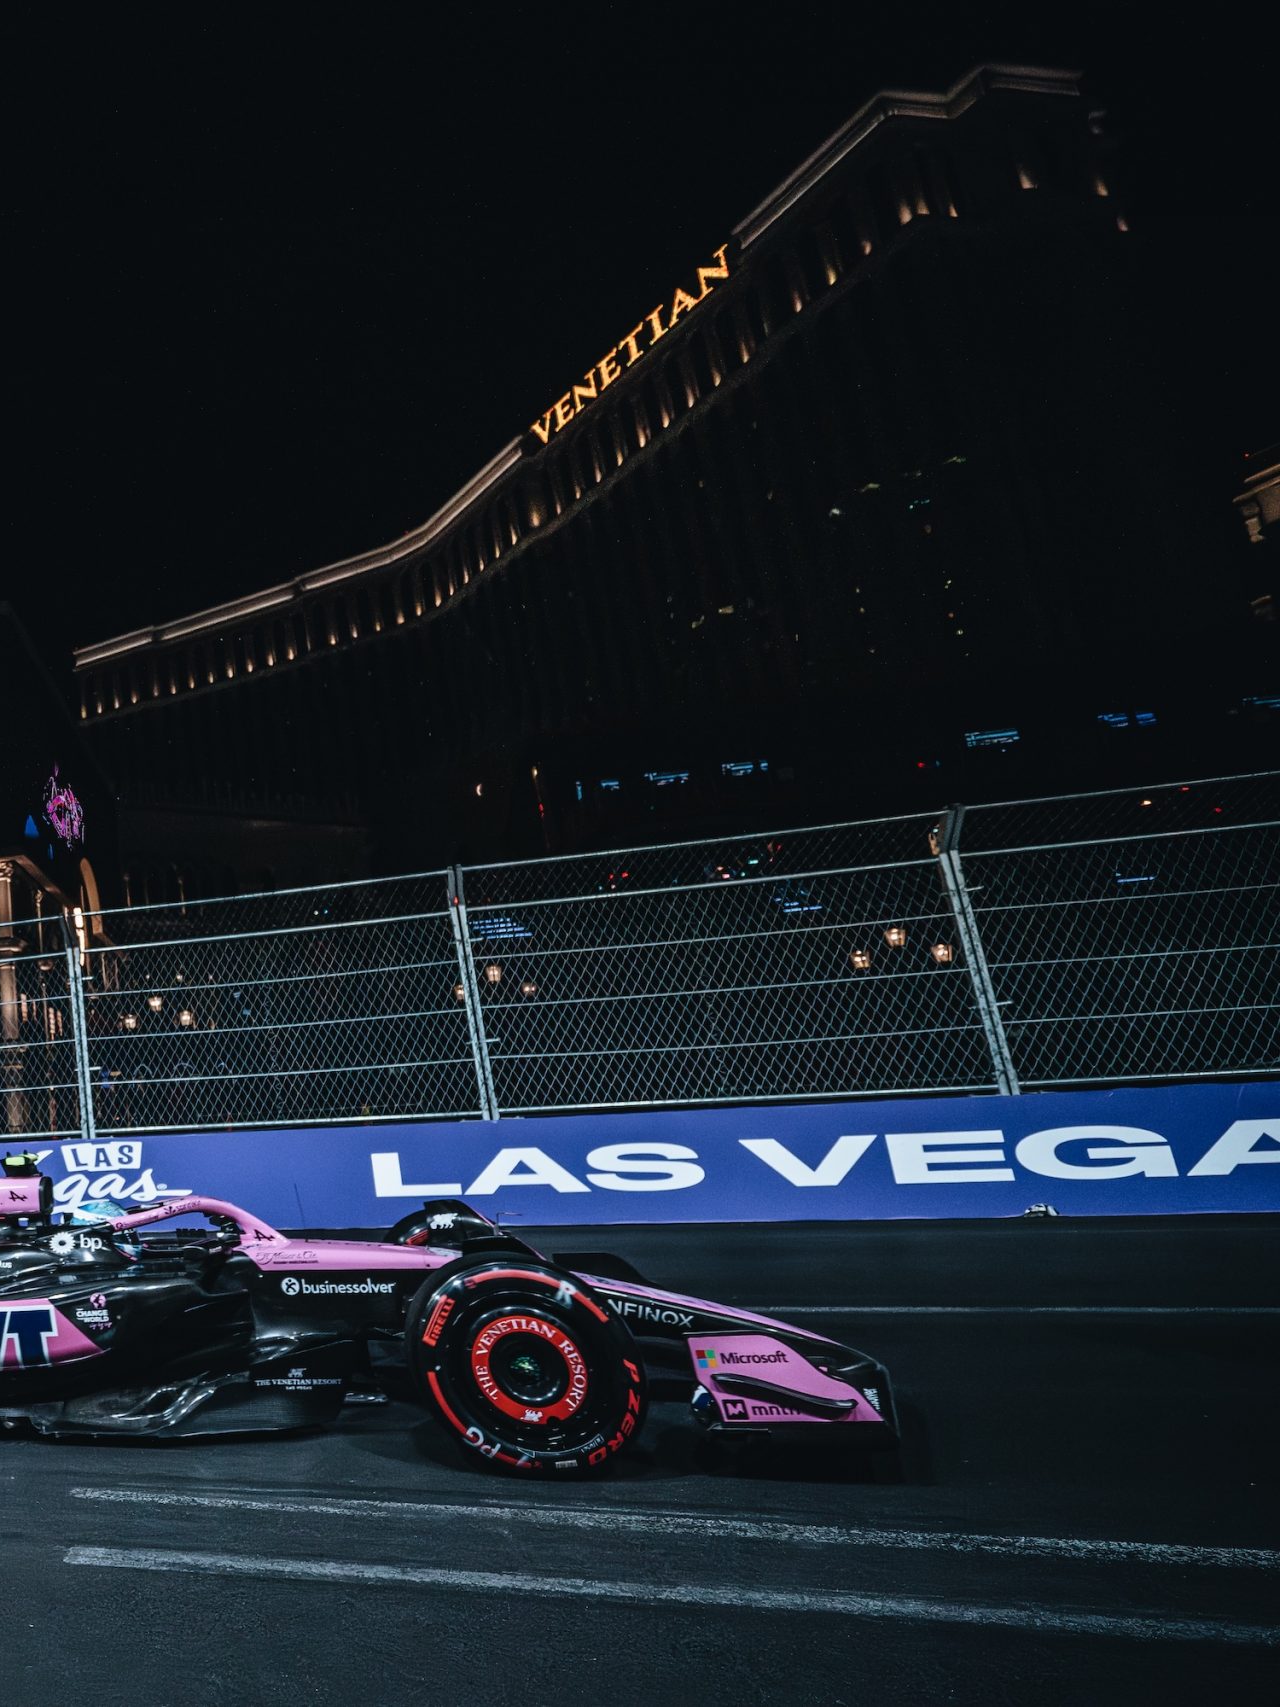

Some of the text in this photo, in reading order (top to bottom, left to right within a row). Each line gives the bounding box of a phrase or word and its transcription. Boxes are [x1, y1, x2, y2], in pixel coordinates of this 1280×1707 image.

[530, 244, 730, 444] VENETIAN
[72, 1143, 135, 1168] LAS
[371, 1142, 706, 1197] LAS
[80, 1235, 102, 1251] bp
[302, 1278, 394, 1294] businessolver
[608, 1299, 694, 1329] NFINOX
[476, 1318, 587, 1412] THE VENETIAN RESORT
[720, 1350, 790, 1365] Microsoft
[272, 1378, 312, 1386] VENETIAN
[313, 1378, 342, 1386] RESORT
[588, 1388, 641, 1467] ZERO
